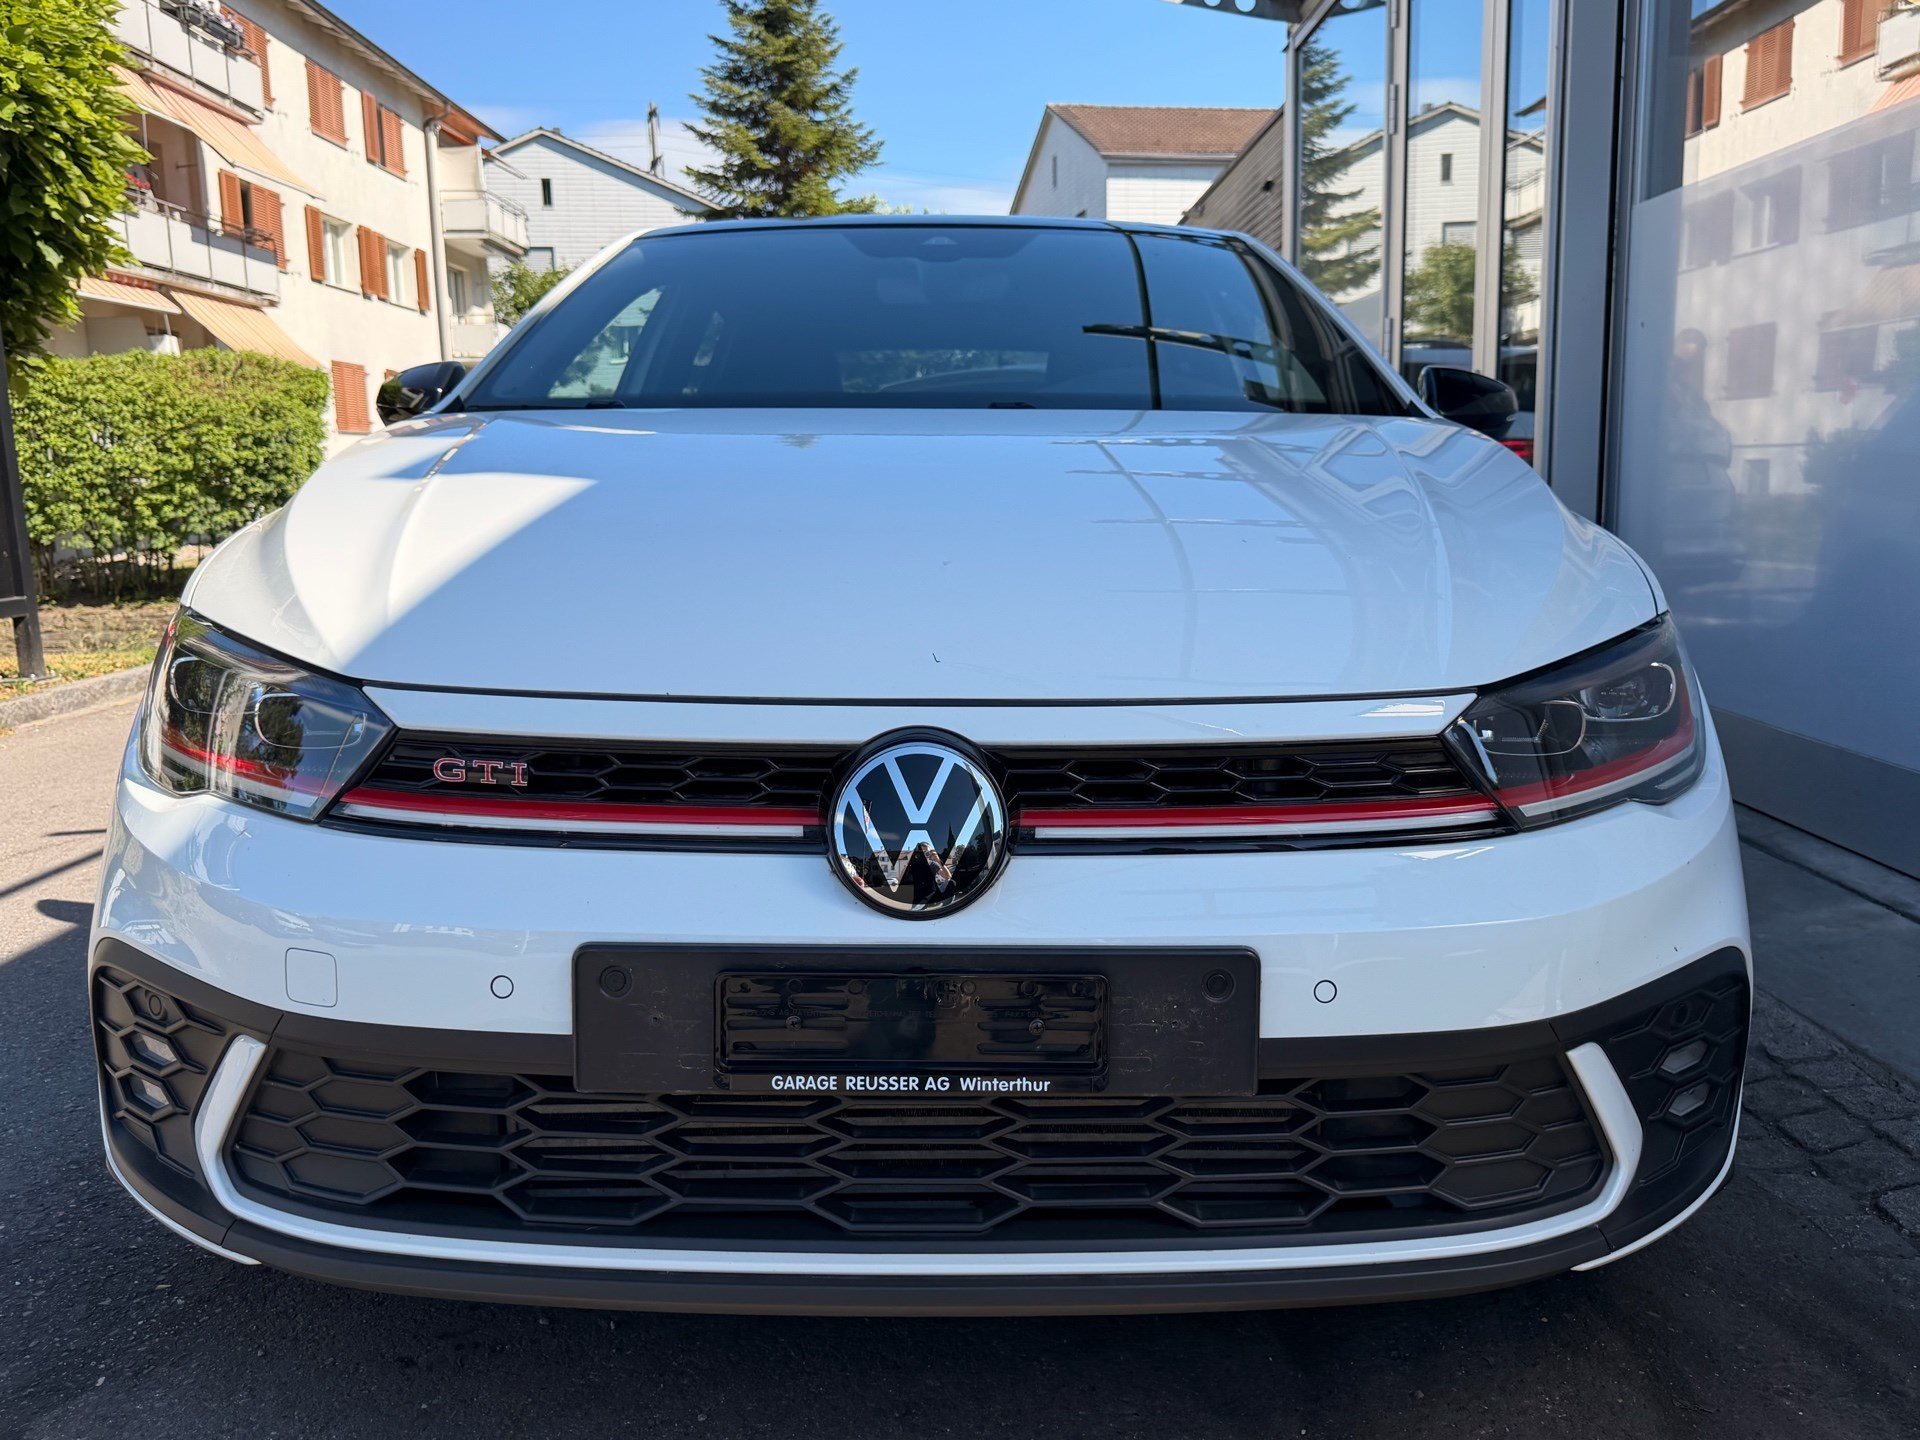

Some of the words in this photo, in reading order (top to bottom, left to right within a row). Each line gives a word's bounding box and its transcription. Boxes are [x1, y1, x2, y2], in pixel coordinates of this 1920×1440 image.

[433, 757, 528, 787] GTI
[771, 1075, 838, 1091] GARAGE
[845, 1075, 919, 1091] REUSSER
[924, 1076, 950, 1091] AG
[959, 1076, 1051, 1092] Winterthur
